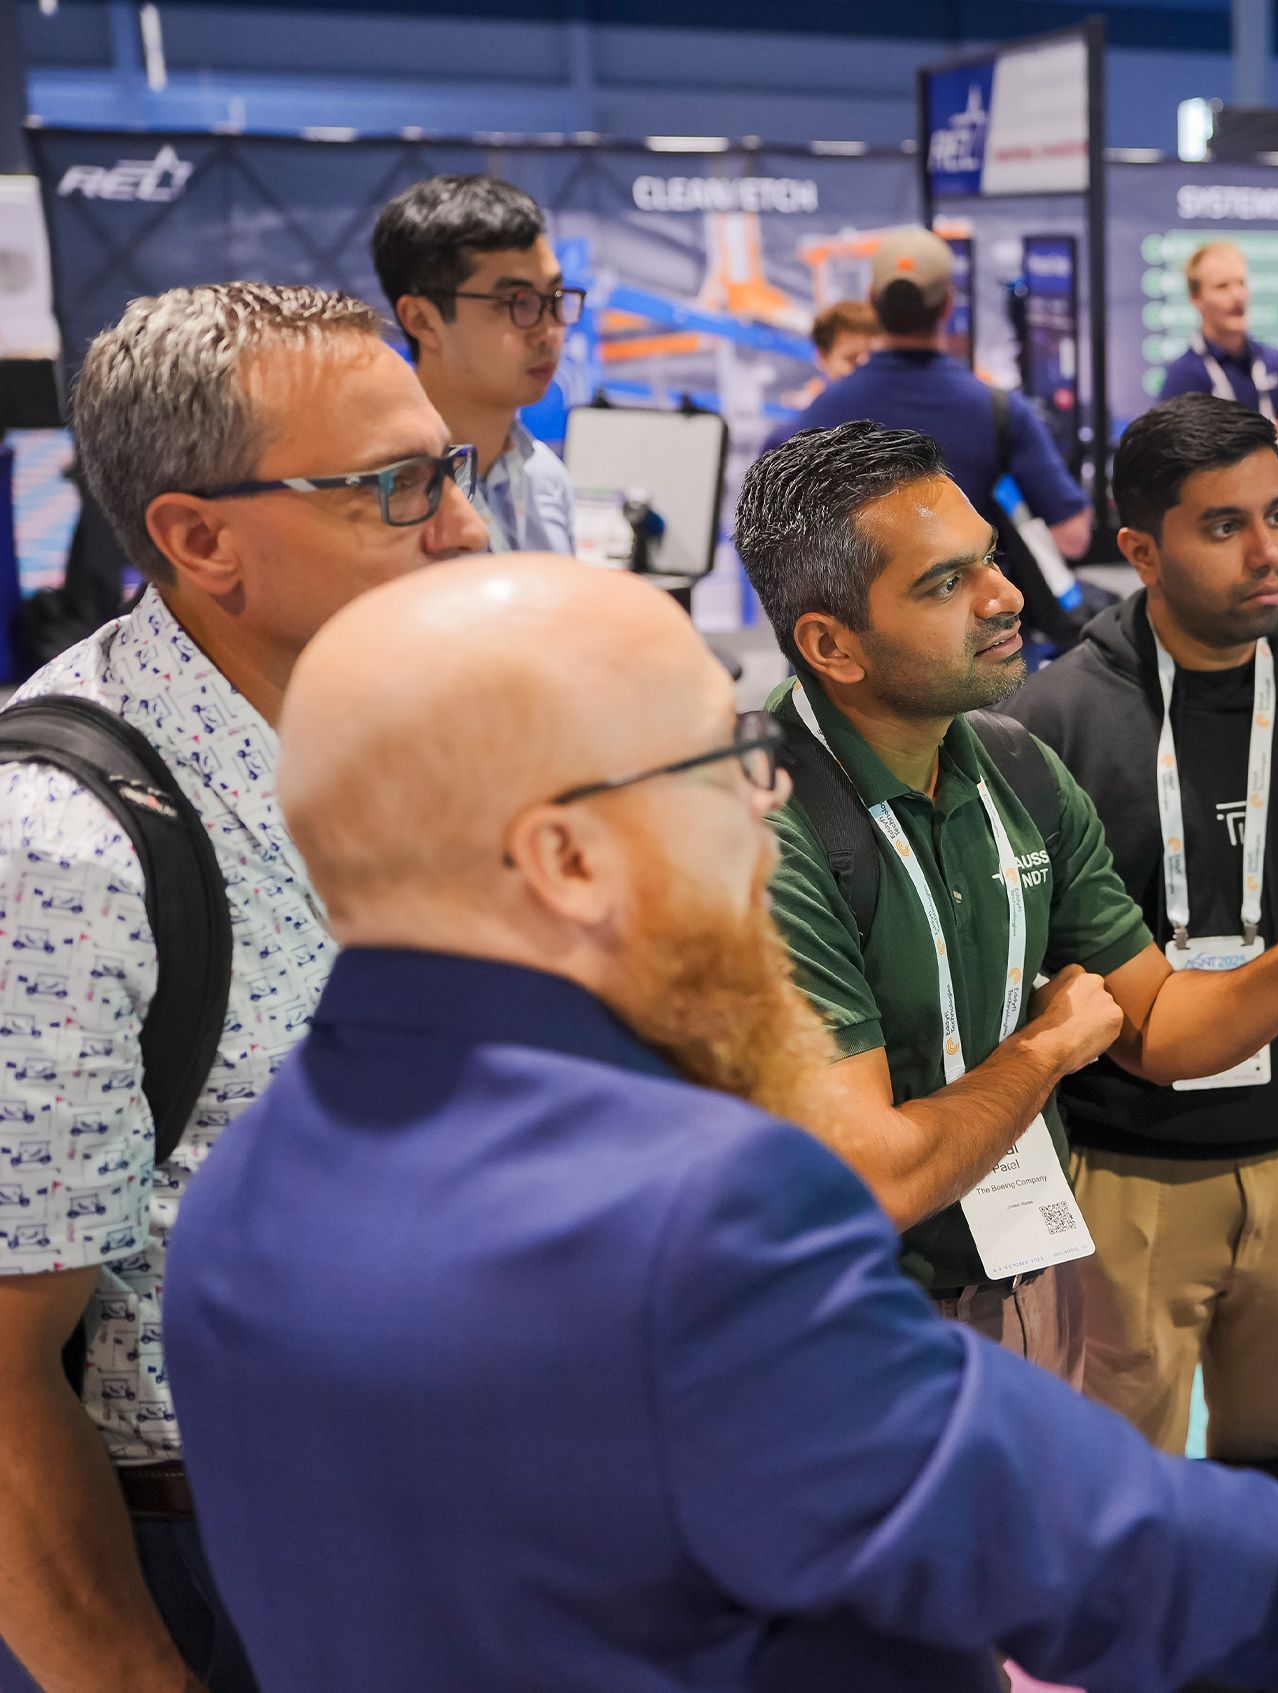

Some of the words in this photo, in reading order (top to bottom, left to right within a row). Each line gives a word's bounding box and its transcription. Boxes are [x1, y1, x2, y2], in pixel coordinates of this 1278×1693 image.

[1014, 849, 1051, 870] AUSS
[1021, 868, 1049, 889] NDT
[992, 1159, 1021, 1175] Patel
[976, 1187, 991, 1196] The
[991, 1181, 1016, 1193] Boeing
[1015, 1175, 1048, 1188] Company
